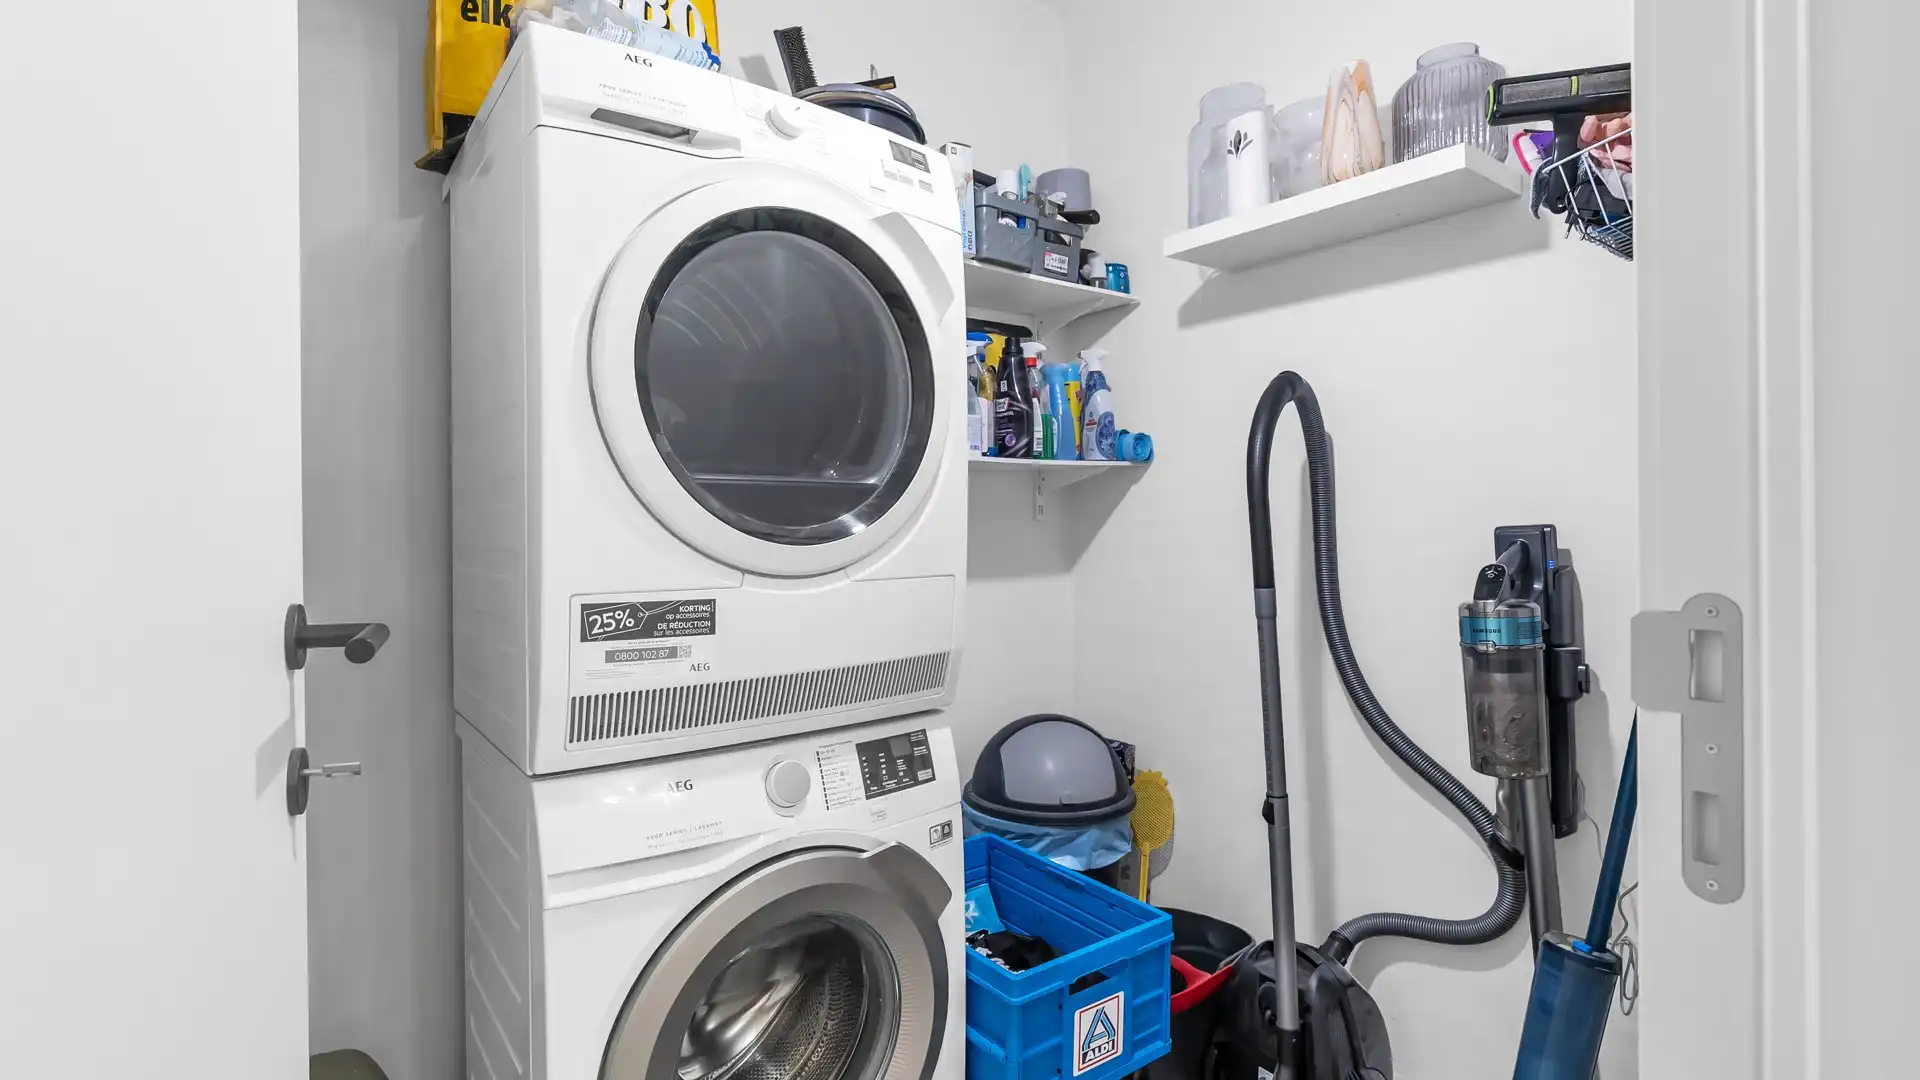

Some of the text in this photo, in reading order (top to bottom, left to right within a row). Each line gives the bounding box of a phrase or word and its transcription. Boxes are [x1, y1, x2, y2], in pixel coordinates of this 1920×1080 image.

[624, 53, 653, 68] AEG
[679, 604, 711, 613] KORTING
[675, 611, 710, 619] accessoires
[588, 608, 635, 635] 25%
[657, 620, 711, 630] DE RÉDUCTION
[614, 649, 670, 661] 0800 102 87
[689, 662, 711, 672] AEG
[667, 779, 693, 793] AEG
[1085, 1040, 1113, 1063] ALDI
